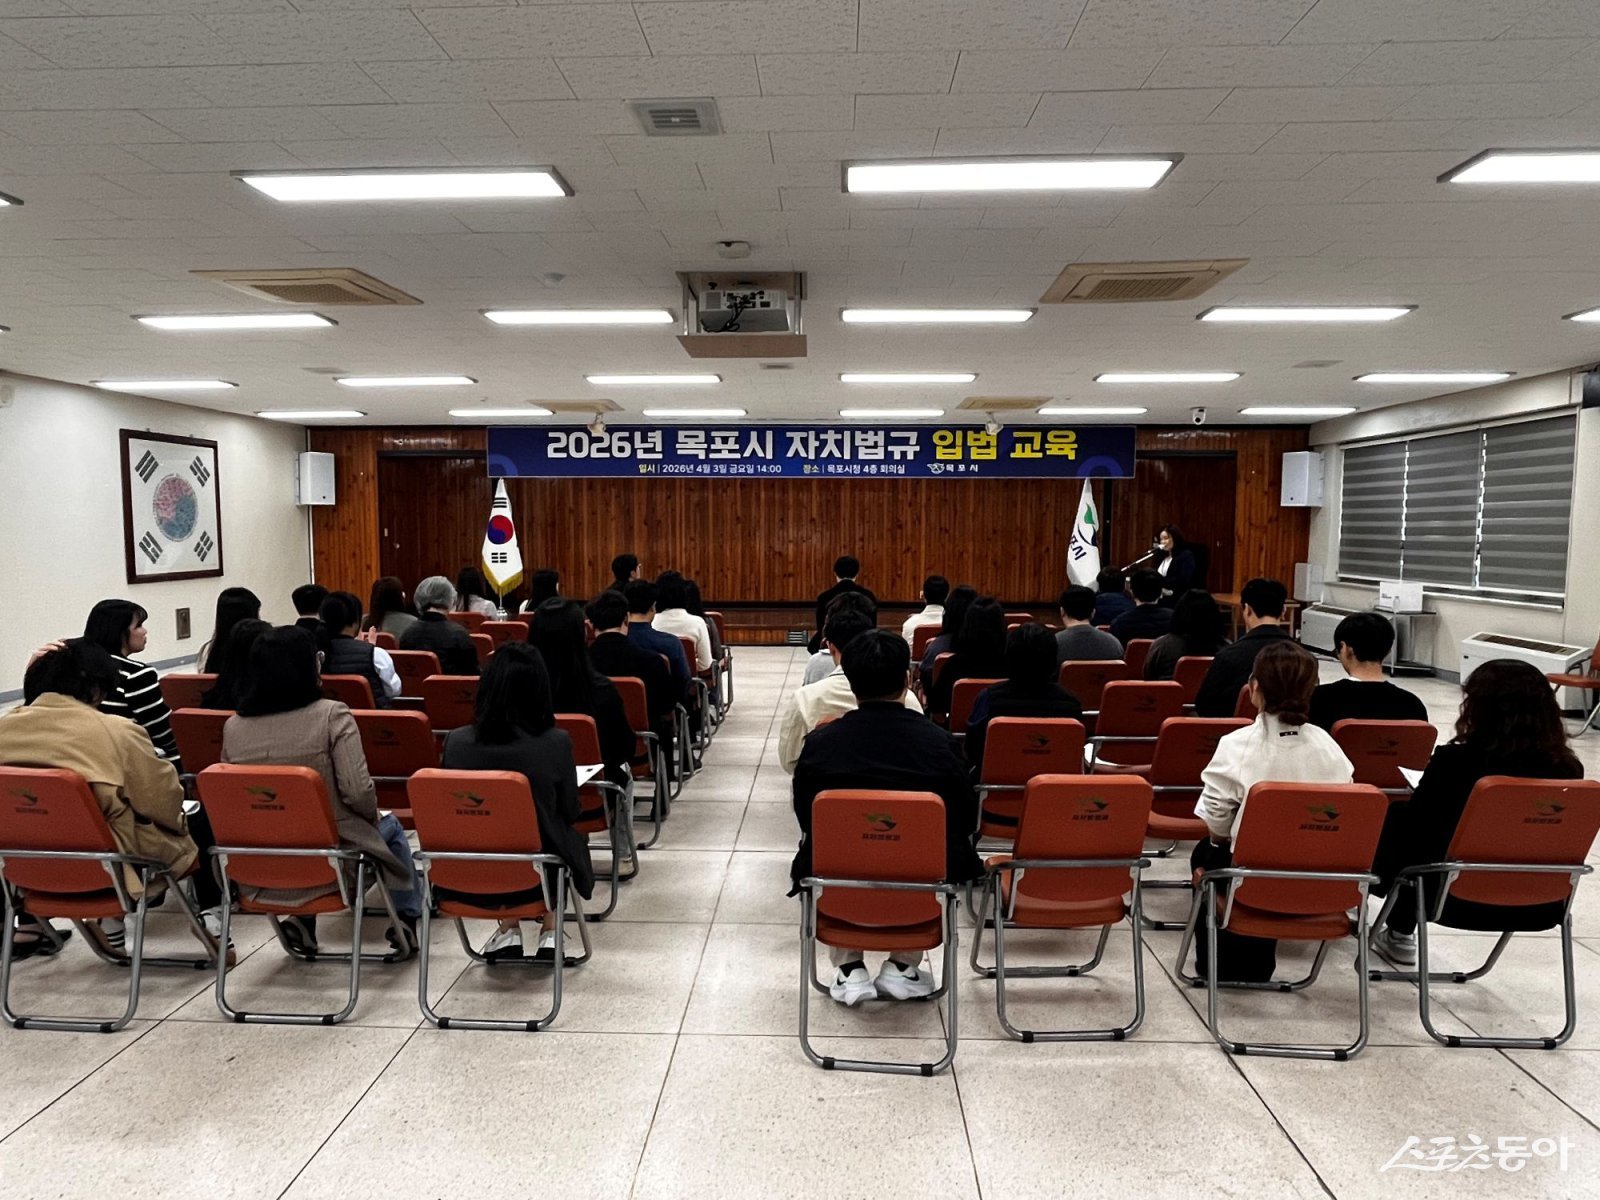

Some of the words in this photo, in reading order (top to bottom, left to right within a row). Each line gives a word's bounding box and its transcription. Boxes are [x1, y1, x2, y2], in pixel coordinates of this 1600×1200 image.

[546, 430, 664, 460] 2026년
[675, 430, 774, 460] 목포시
[785, 429, 920, 460] 자치법규
[931, 429, 998, 460] 입법
[1009, 429, 1079, 460] 교육
[638, 464, 656, 474] 일시
[662, 464, 694, 474] 2026년
[696, 464, 711, 474] 4월
[713, 464, 727, 474] 3일
[729, 464, 754, 474] 금요일
[757, 464, 782, 473] 14:00
[803, 464, 820, 474] 장소
[827, 464, 861, 475] 목포시청
[863, 464, 878, 474] 4층
[880, 464, 906, 474] 회의실
[945, 463, 979, 473] 목포시
